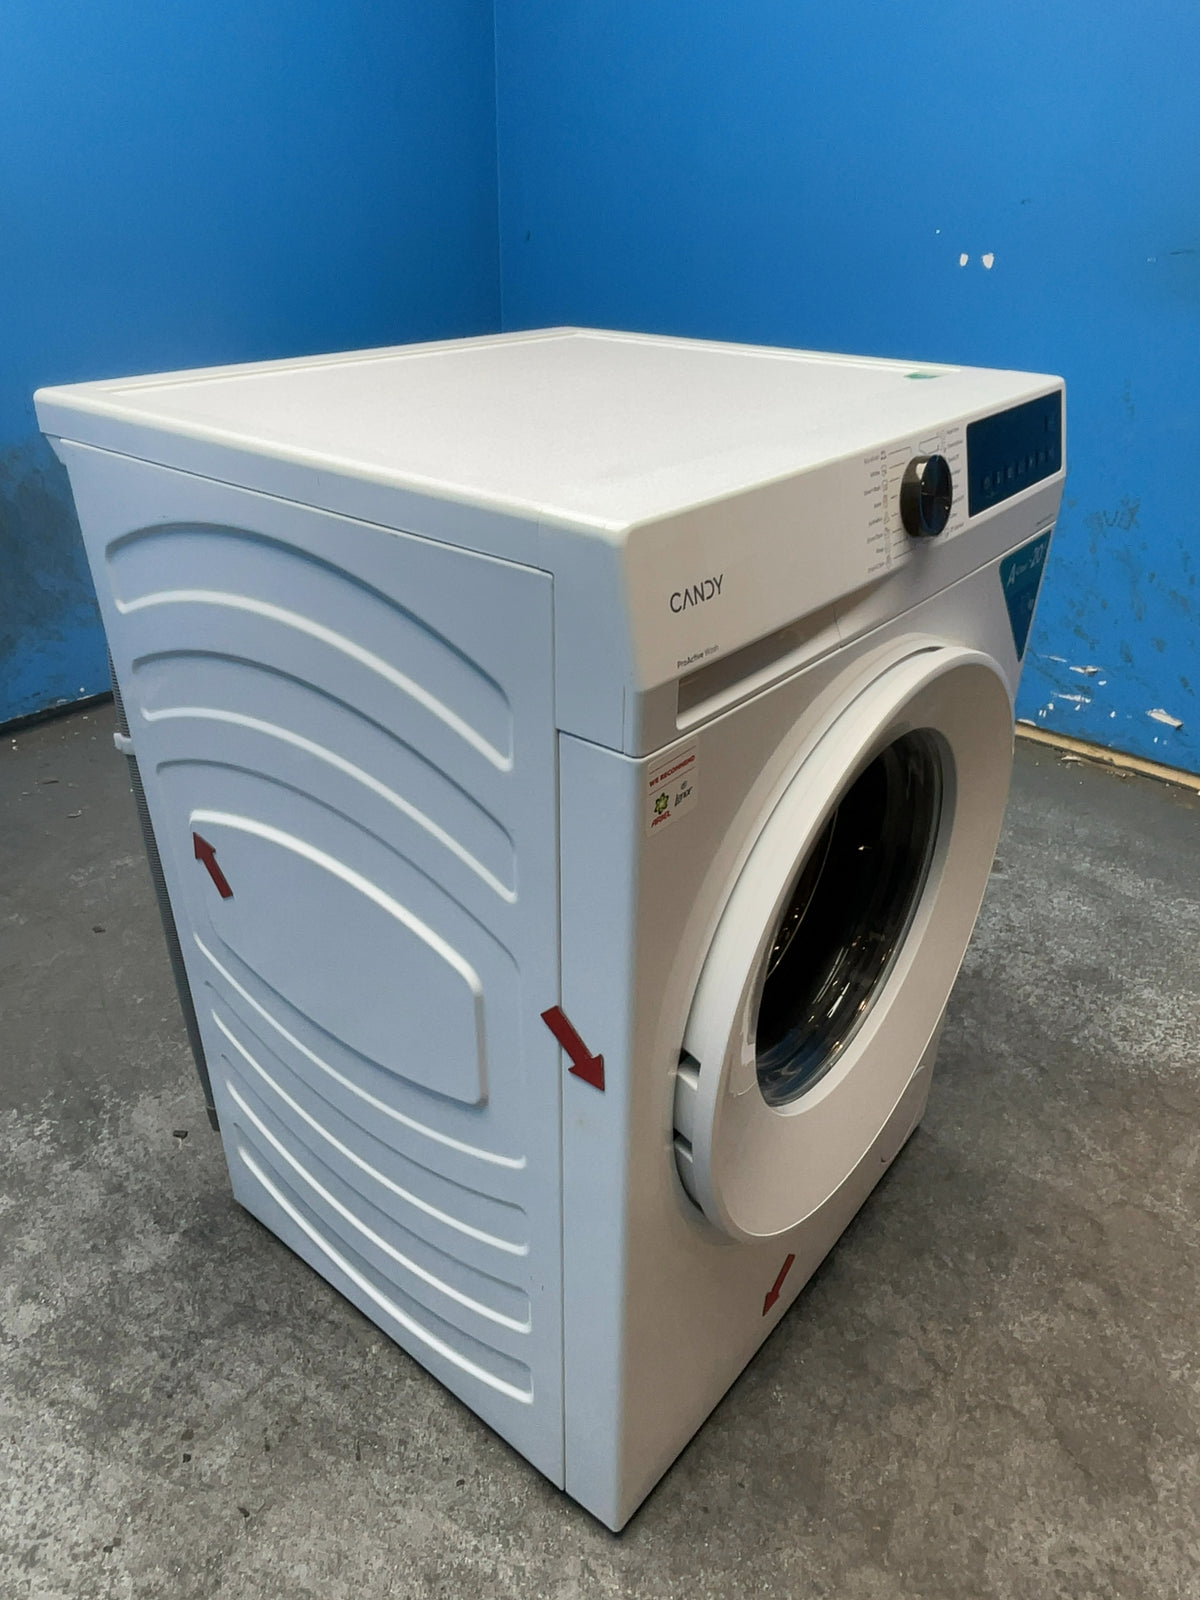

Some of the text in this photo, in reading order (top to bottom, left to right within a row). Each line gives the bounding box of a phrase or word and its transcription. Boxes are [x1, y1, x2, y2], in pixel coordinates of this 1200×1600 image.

[669, 573, 724, 613] CANDY
[649, 754, 696, 788] WE RECOMMEND
